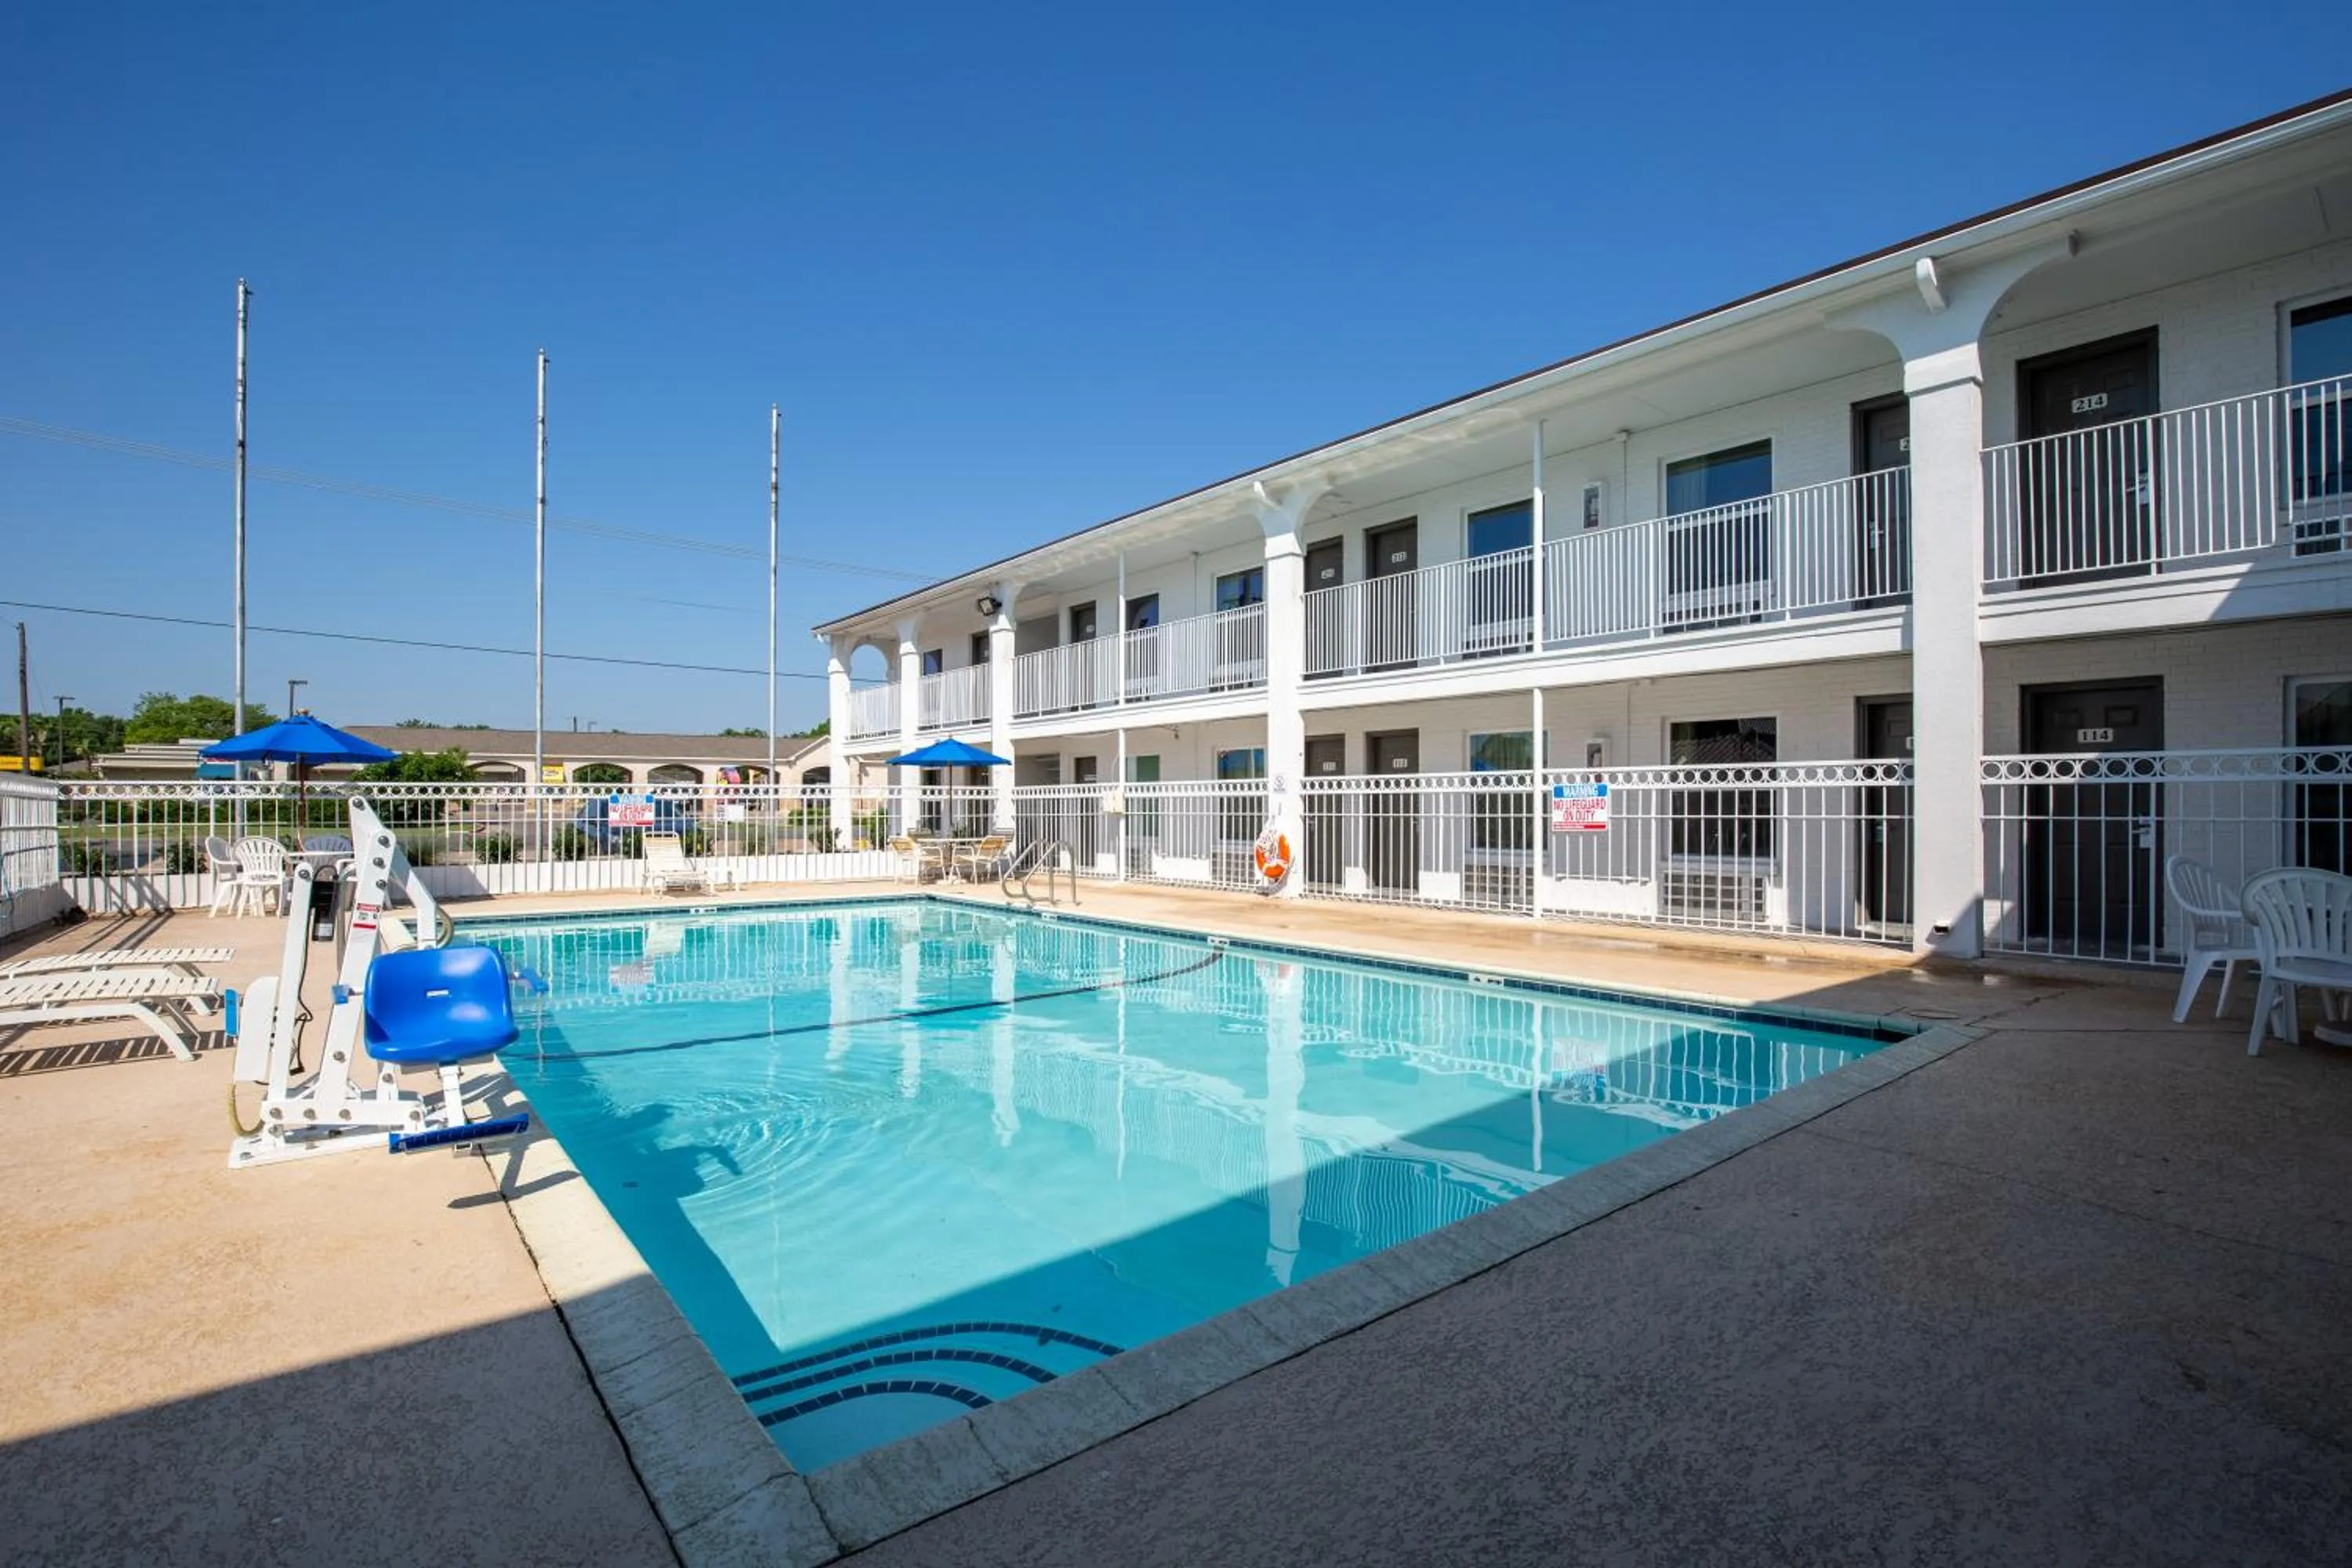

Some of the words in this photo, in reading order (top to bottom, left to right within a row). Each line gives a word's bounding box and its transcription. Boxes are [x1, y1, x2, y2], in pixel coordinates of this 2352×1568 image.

[2075, 394, 2103, 411] 214
[2082, 729, 2109, 741] 114
[1563, 784, 1599, 797] WARNING
[1554, 799, 1563, 811] NO
[1565, 798, 1606, 811] LIFEGUARD
[1563, 810, 1573, 821] ON
[1575, 809, 1595, 821] DUTY
